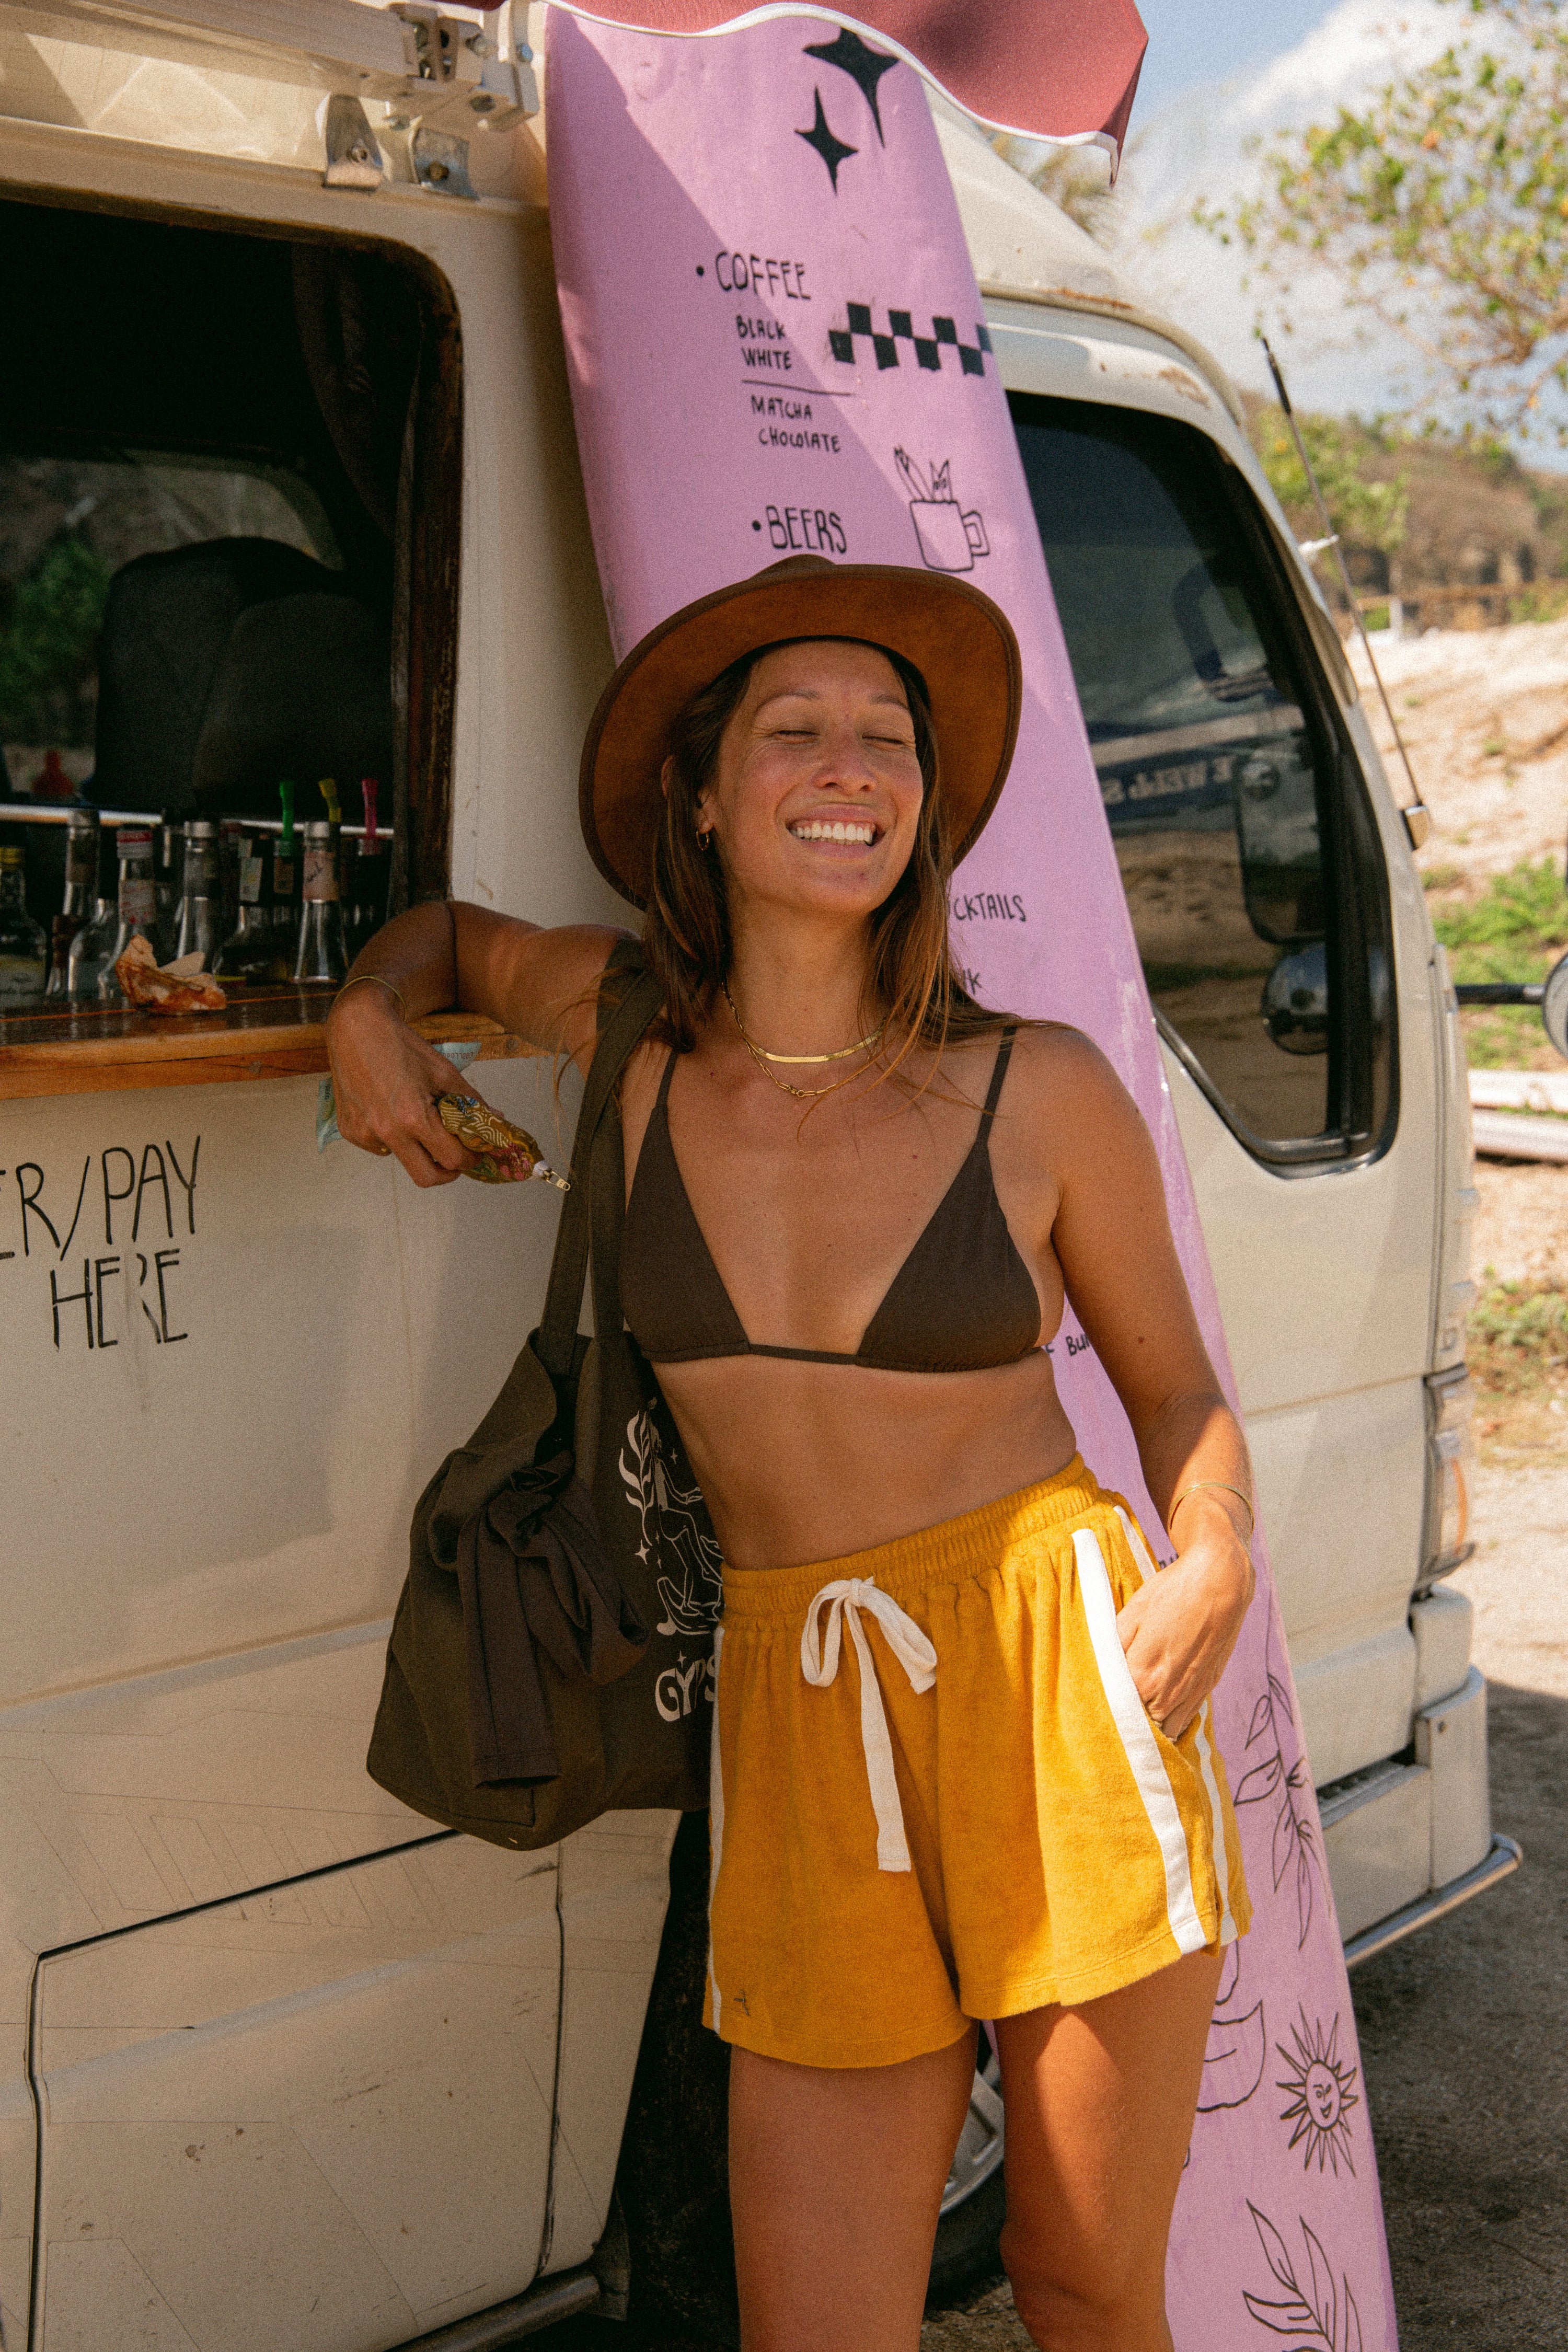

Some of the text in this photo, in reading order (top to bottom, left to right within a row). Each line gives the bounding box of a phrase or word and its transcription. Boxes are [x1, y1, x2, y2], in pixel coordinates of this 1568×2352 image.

[715, 250, 812, 299] COFFEE
[736, 314, 786, 340] BLACK
[741, 348, 792, 369] WHITE
[751, 394, 813, 420] MATCHA
[766, 504, 847, 554] BEERS
[948, 892, 1027, 922] CKTAILS
[0, 1135, 201, 1261] R/PAY
